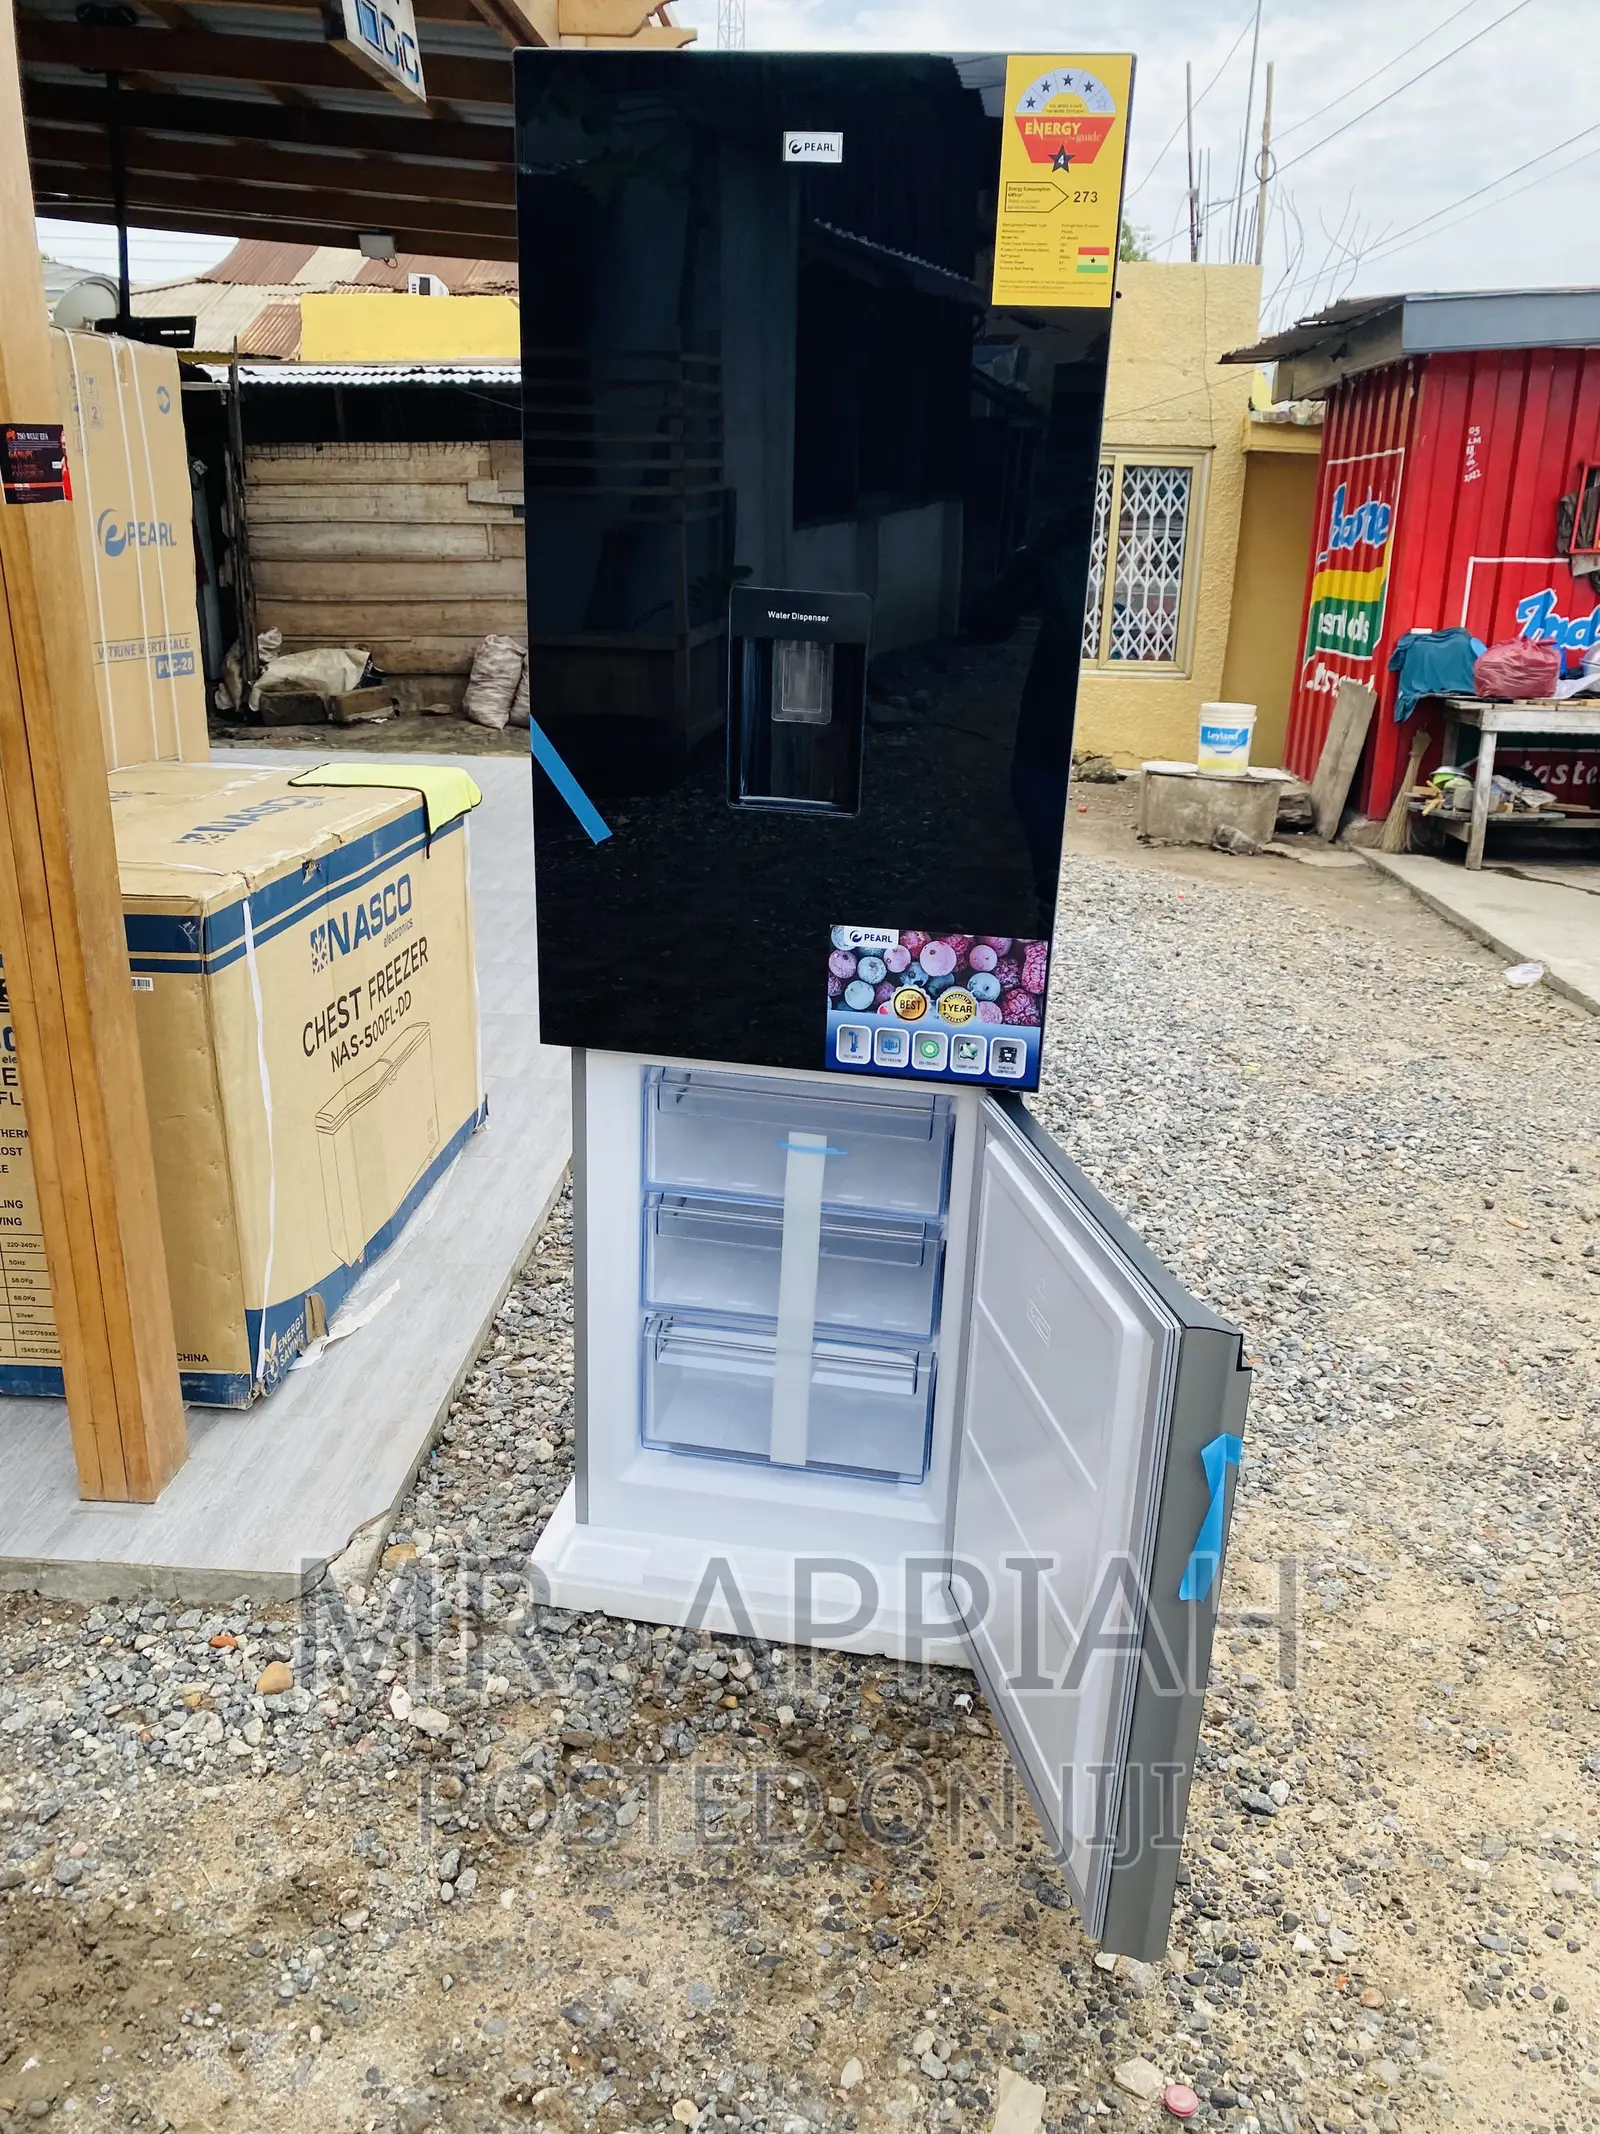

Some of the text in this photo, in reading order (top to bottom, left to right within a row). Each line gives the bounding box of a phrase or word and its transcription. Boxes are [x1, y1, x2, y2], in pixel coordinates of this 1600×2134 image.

[1025, 118, 1082, 140] ENERGY
[1076, 131, 1102, 143] guide
[804, 142, 836, 152] PEARL
[1057, 154, 1065, 165] 4
[1073, 190, 1098, 203] 273
[126, 521, 177, 547] PEARL
[767, 610, 830, 623] Water Dispenser
[97, 643, 137, 660] VTRINE
[327, 873, 412, 962] NASCO
[383, 917, 413, 948] electronics
[863, 933, 893, 943] PEARL
[302, 936, 429, 1057] CHEST FREEZER
[899, 1000, 921, 1010] BEST
[947, 1003, 973, 1013] YEAR
[330, 989, 412, 1073] NAS-500FL-DD
[277, 1311, 305, 1353] ENERGY
[279, 1330, 305, 1367] SAVING
